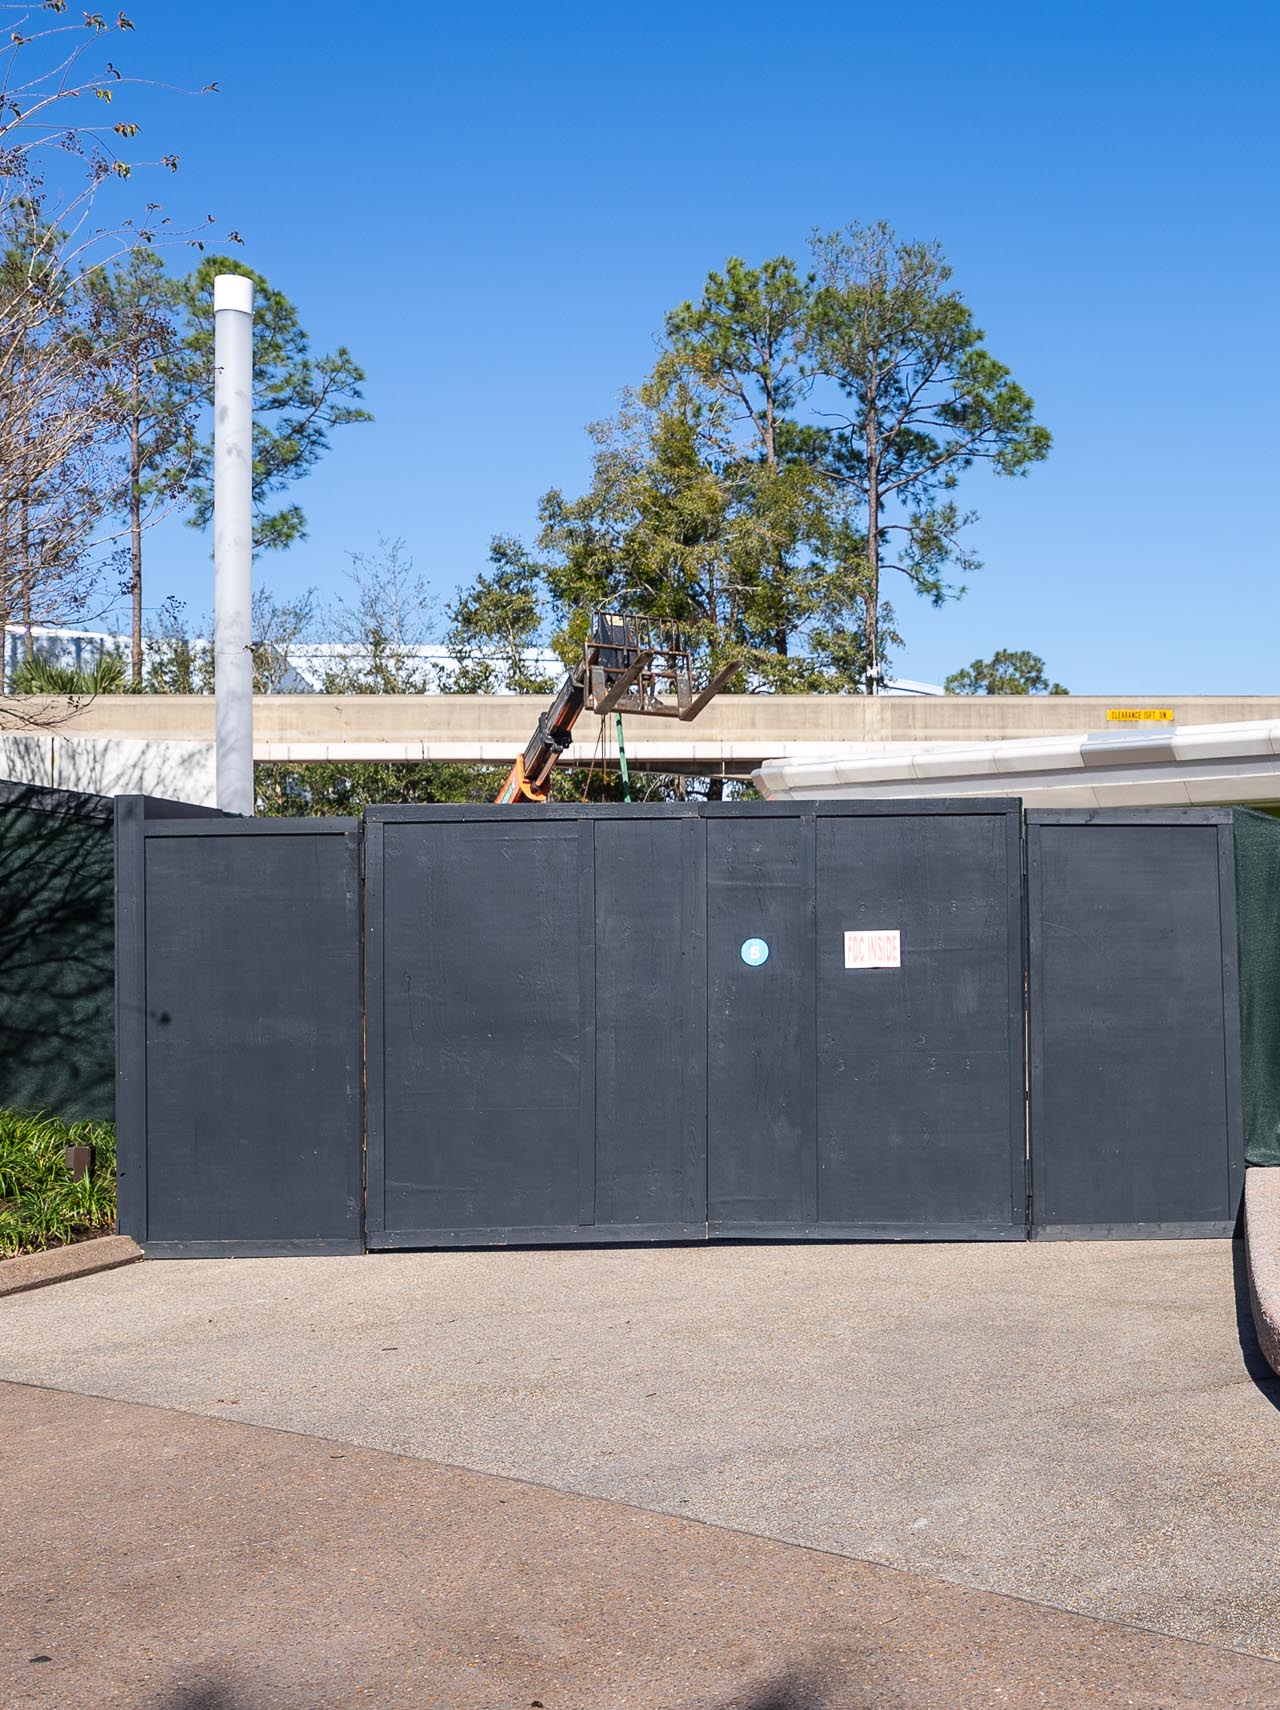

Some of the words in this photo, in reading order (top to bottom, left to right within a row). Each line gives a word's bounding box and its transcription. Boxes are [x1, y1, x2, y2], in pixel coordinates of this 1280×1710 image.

[1111, 711, 1142, 720] CLEARANCE
[847, 936, 865, 962] FDC
[867, 935, 897, 962] INSIDE
